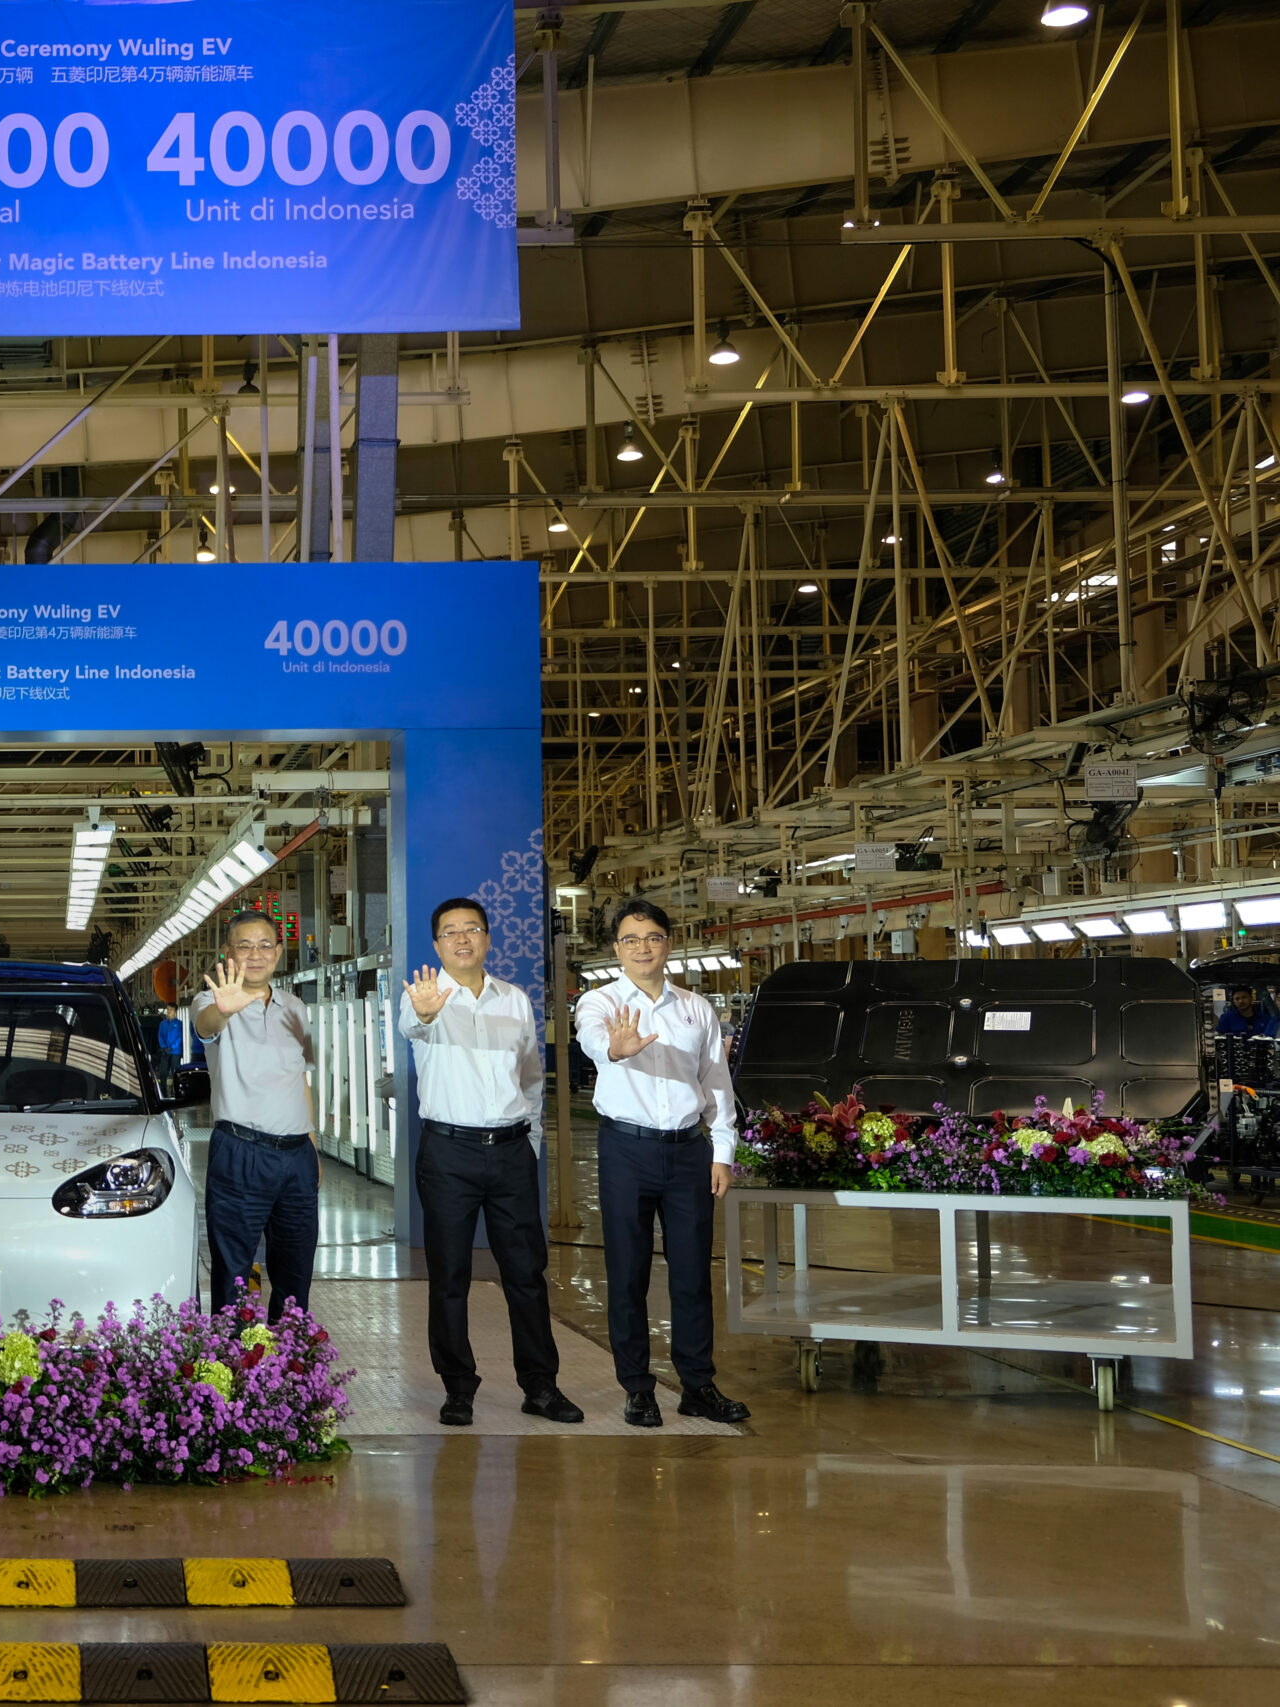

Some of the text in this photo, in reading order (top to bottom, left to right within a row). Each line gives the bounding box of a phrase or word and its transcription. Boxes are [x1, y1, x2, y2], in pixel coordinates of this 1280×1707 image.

[1, 40, 112, 61] Ceremony
[119, 38, 193, 60] Wuling
[203, 38, 232, 55] EV
[51, 65, 254, 84] 五菱印尼第4万辆新能源车
[147, 110, 451, 187] 40000
[186, 196, 414, 221] Unit di Indonesia
[9, 253, 74, 275] Magic
[82, 253, 163, 275] Battery
[171, 252, 215, 270] Line
[223, 250, 327, 270] Indonesia
[33, 604, 91, 622] Wuling
[97, 604, 121, 618] EV
[264, 619, 408, 657] 40000
[6, 665, 69, 683] Battery
[75, 665, 110, 680] Line
[115, 664, 196, 680] Indonesia
[282, 661, 391, 673] Unit di Indonesia
